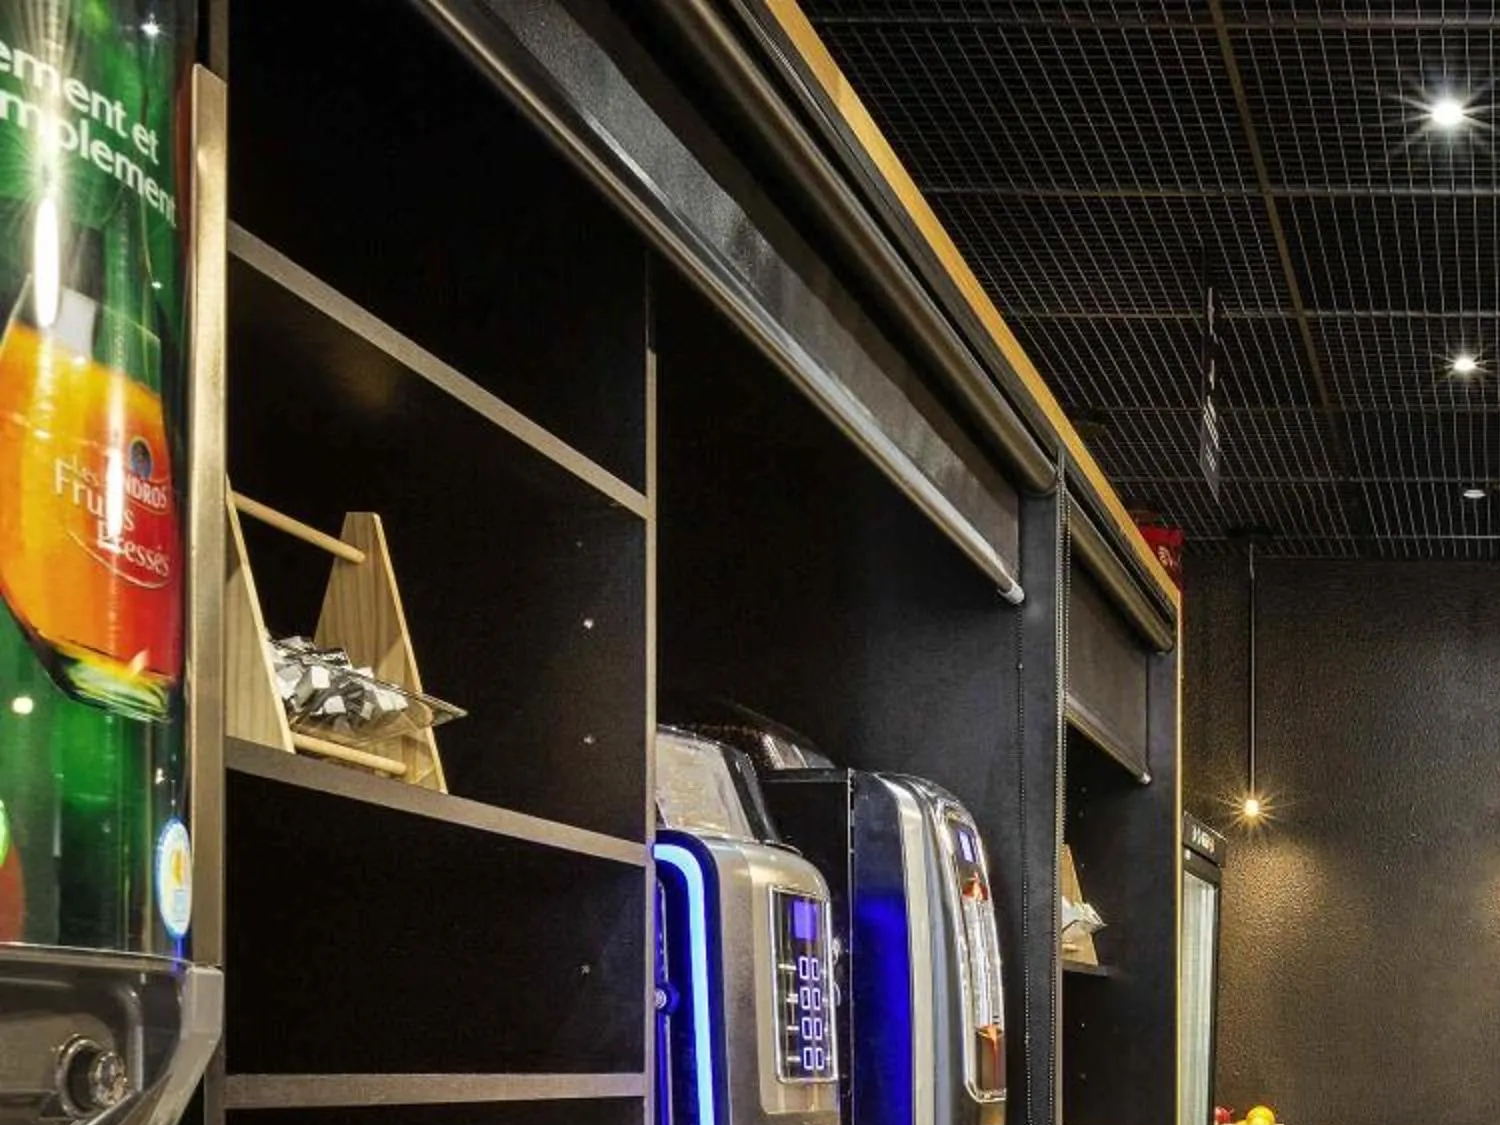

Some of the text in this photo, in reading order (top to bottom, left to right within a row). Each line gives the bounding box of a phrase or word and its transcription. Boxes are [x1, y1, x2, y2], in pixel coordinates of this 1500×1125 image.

[132, 123, 160, 165] et
[56, 457, 135, 532] Frus
[121, 474, 168, 510] NDROS
